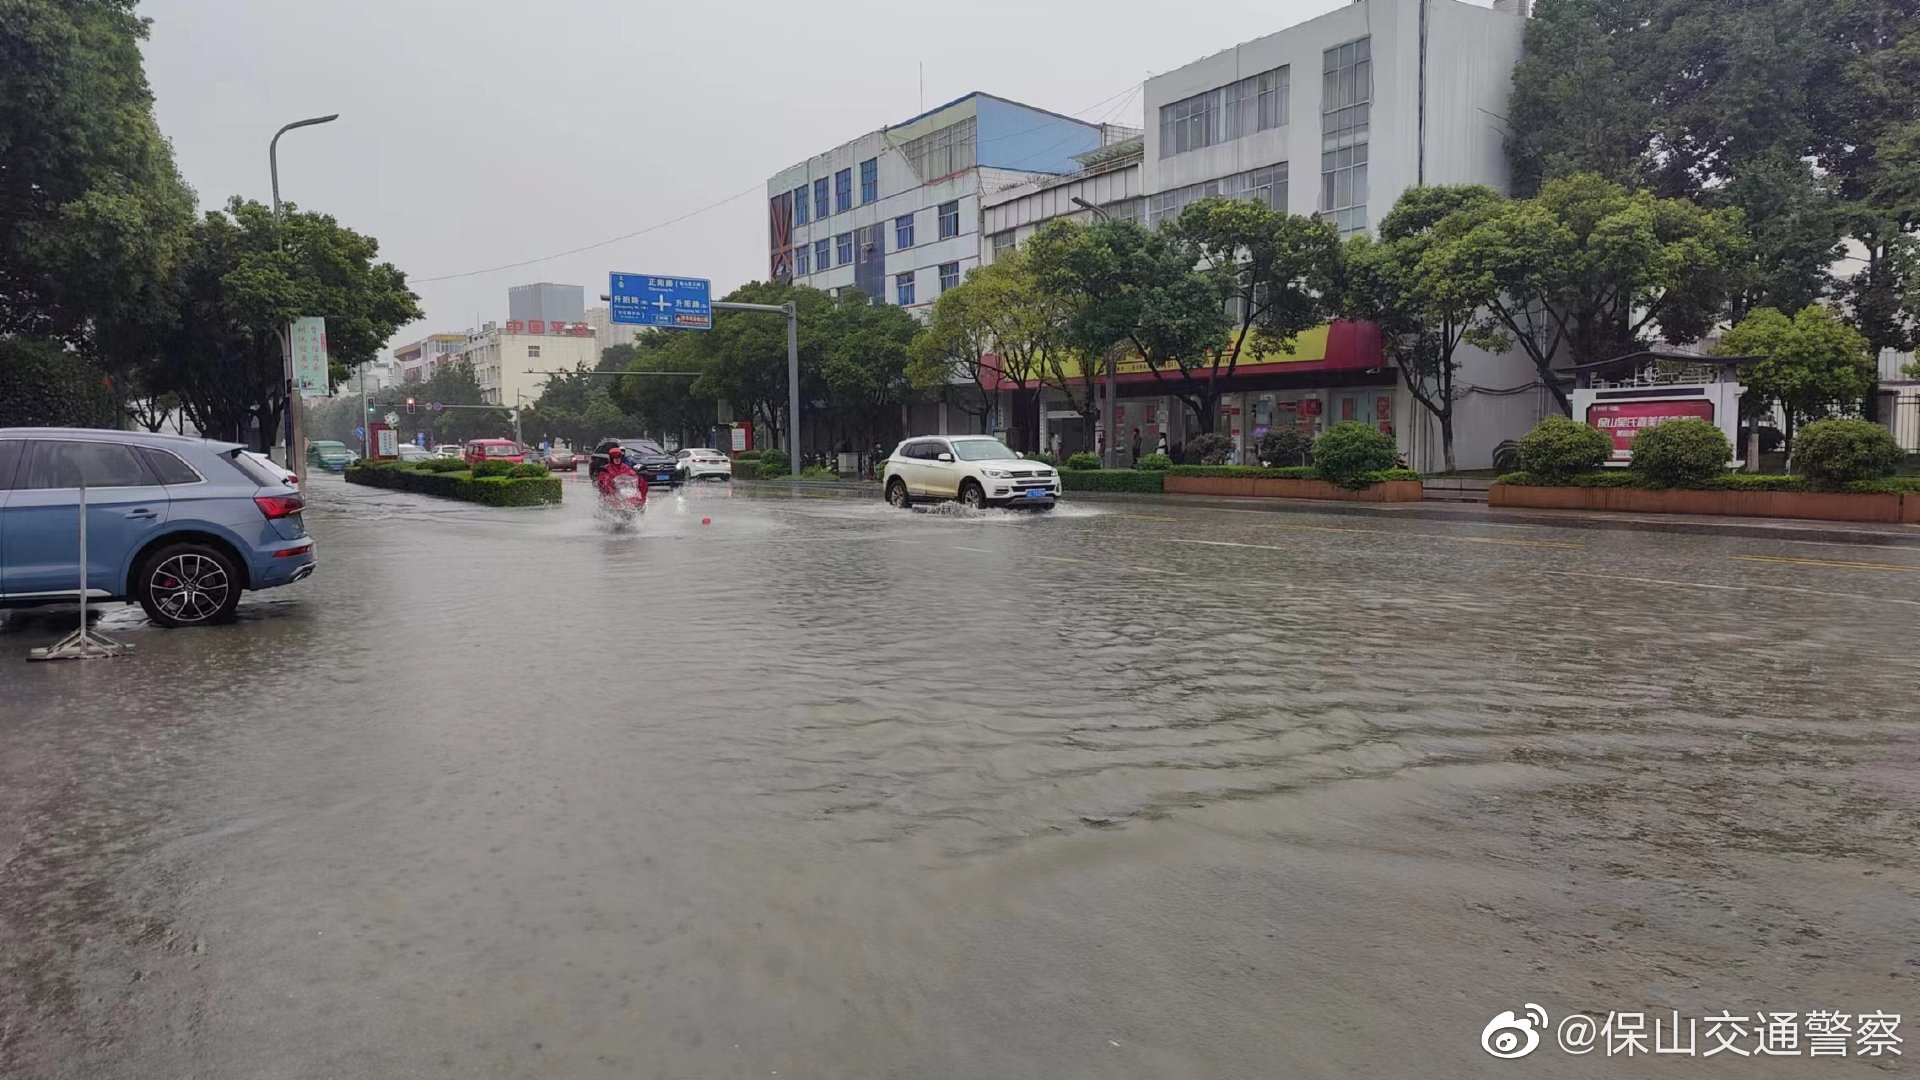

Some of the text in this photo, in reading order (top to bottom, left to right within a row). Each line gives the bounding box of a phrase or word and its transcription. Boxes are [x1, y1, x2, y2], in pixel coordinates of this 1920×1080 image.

[648, 278, 673, 288] 正阳路
[614, 295, 639, 305] 升阳路
[675, 299, 700, 308] 升阳路
[506, 320, 589, 335] 中国平安
